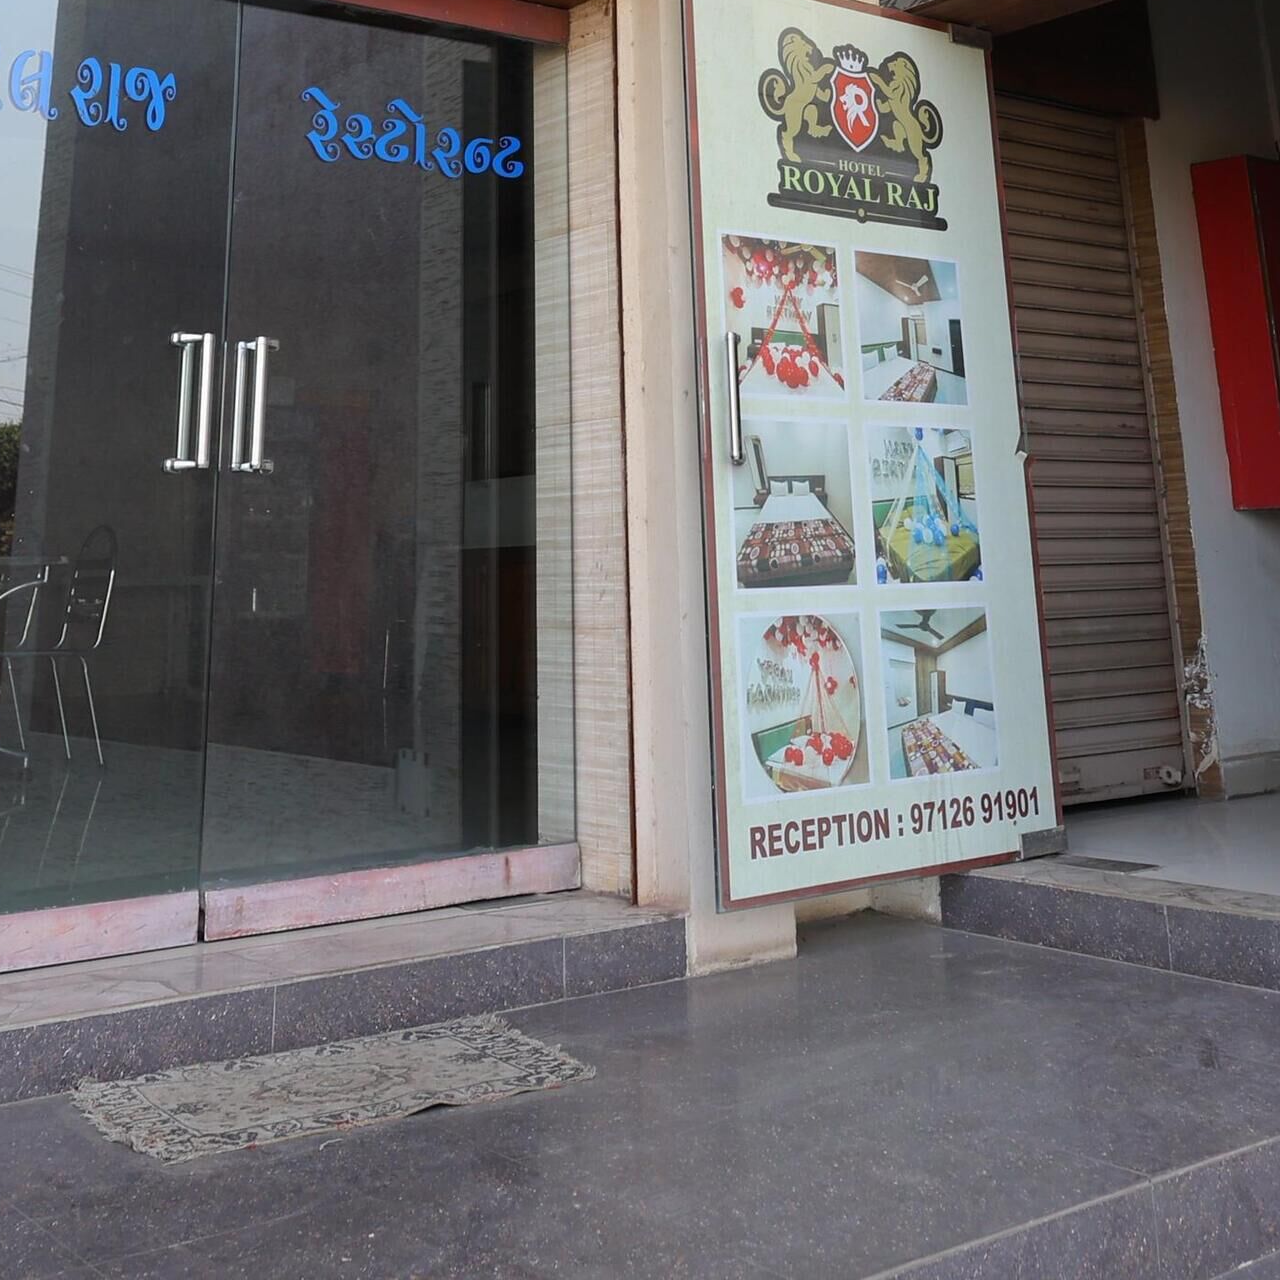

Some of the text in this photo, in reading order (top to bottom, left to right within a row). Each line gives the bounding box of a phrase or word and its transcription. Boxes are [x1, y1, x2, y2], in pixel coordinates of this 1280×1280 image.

[70, 56, 177, 131] રાજ
[782, 165, 935, 212] ROYAL RAJ
[839, 159, 885, 178] HOTEL
[750, 808, 890, 860] RECEPTION
[910, 795, 975, 834] 97126
[980, 786, 1040, 824] 91901
